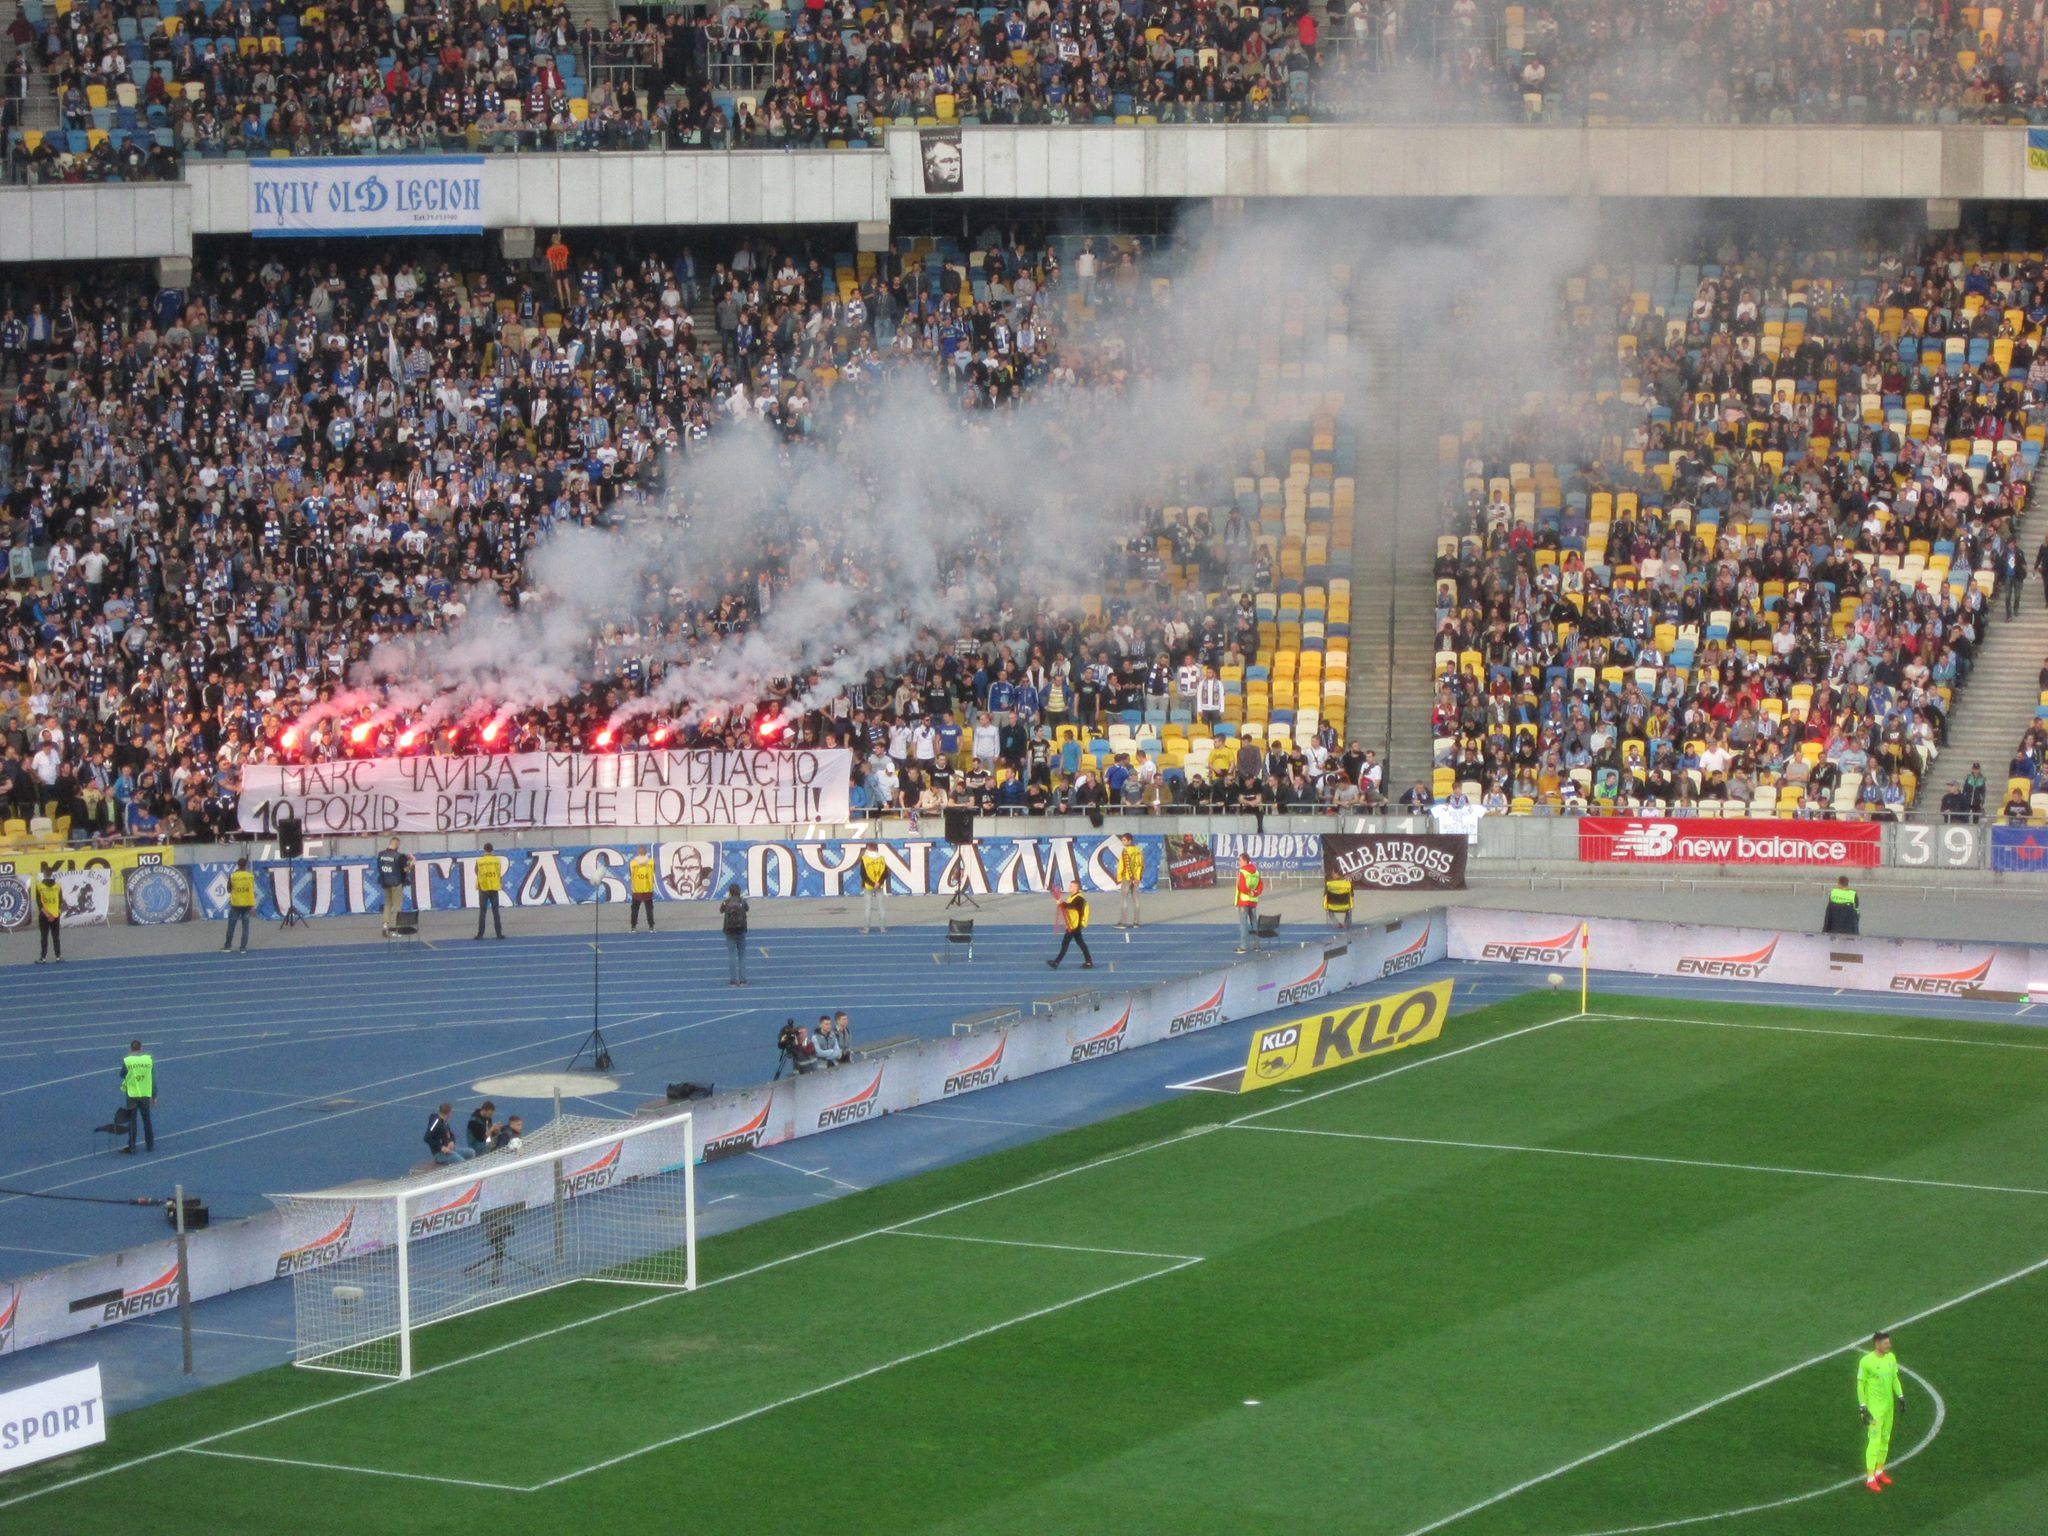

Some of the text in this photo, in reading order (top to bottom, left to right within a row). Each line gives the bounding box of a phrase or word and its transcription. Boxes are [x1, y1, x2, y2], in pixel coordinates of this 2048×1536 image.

[328, 175, 389, 213] OLD
[396, 179, 481, 211] LEGION
[280, 760, 376, 797] МАКС
[399, 754, 521, 793] ЧАЙКА
[545, 752, 598, 789] МИ
[252, 796, 295, 833] 10
[304, 794, 399, 833] РОКІВ
[436, 788, 550, 832] ВБИВЦІ
[567, 789, 618, 825] НЕ
[635, 786, 823, 825] ПОКАРАНІ!
[1215, 832, 1320, 858] BADBOYS
[1336, 841, 1454, 875] ALBATROSS
[1679, 835, 1847, 860] new balance
[1901, 825, 1974, 866] 39
[138, 854, 161, 866] KLO
[1382, 949, 1426, 976] ENERGY
[1481, 943, 1571, 963] ENERGY
[1675, 958, 1768, 978] ENERGY
[1277, 979, 1325, 1005] ENERGY
[1889, 975, 1984, 997] ENERGY
[1169, 1006, 1222, 1034] ENERGY
[1311, 991, 1438, 1068] KLO
[1071, 1033, 1125, 1061] ENERGY
[1261, 1028, 1298, 1052] KLO
[943, 1064, 1000, 1095] ENERGY
[817, 1098, 879, 1128] ENERGY
[560, 1166, 618, 1194] NERGY
[408, 1202, 478, 1237] ENERGY
[275, 1239, 348, 1277] ENERGY
[103, 1282, 180, 1322] ENERGY
[1, 1397, 98, 1450] SPORT
